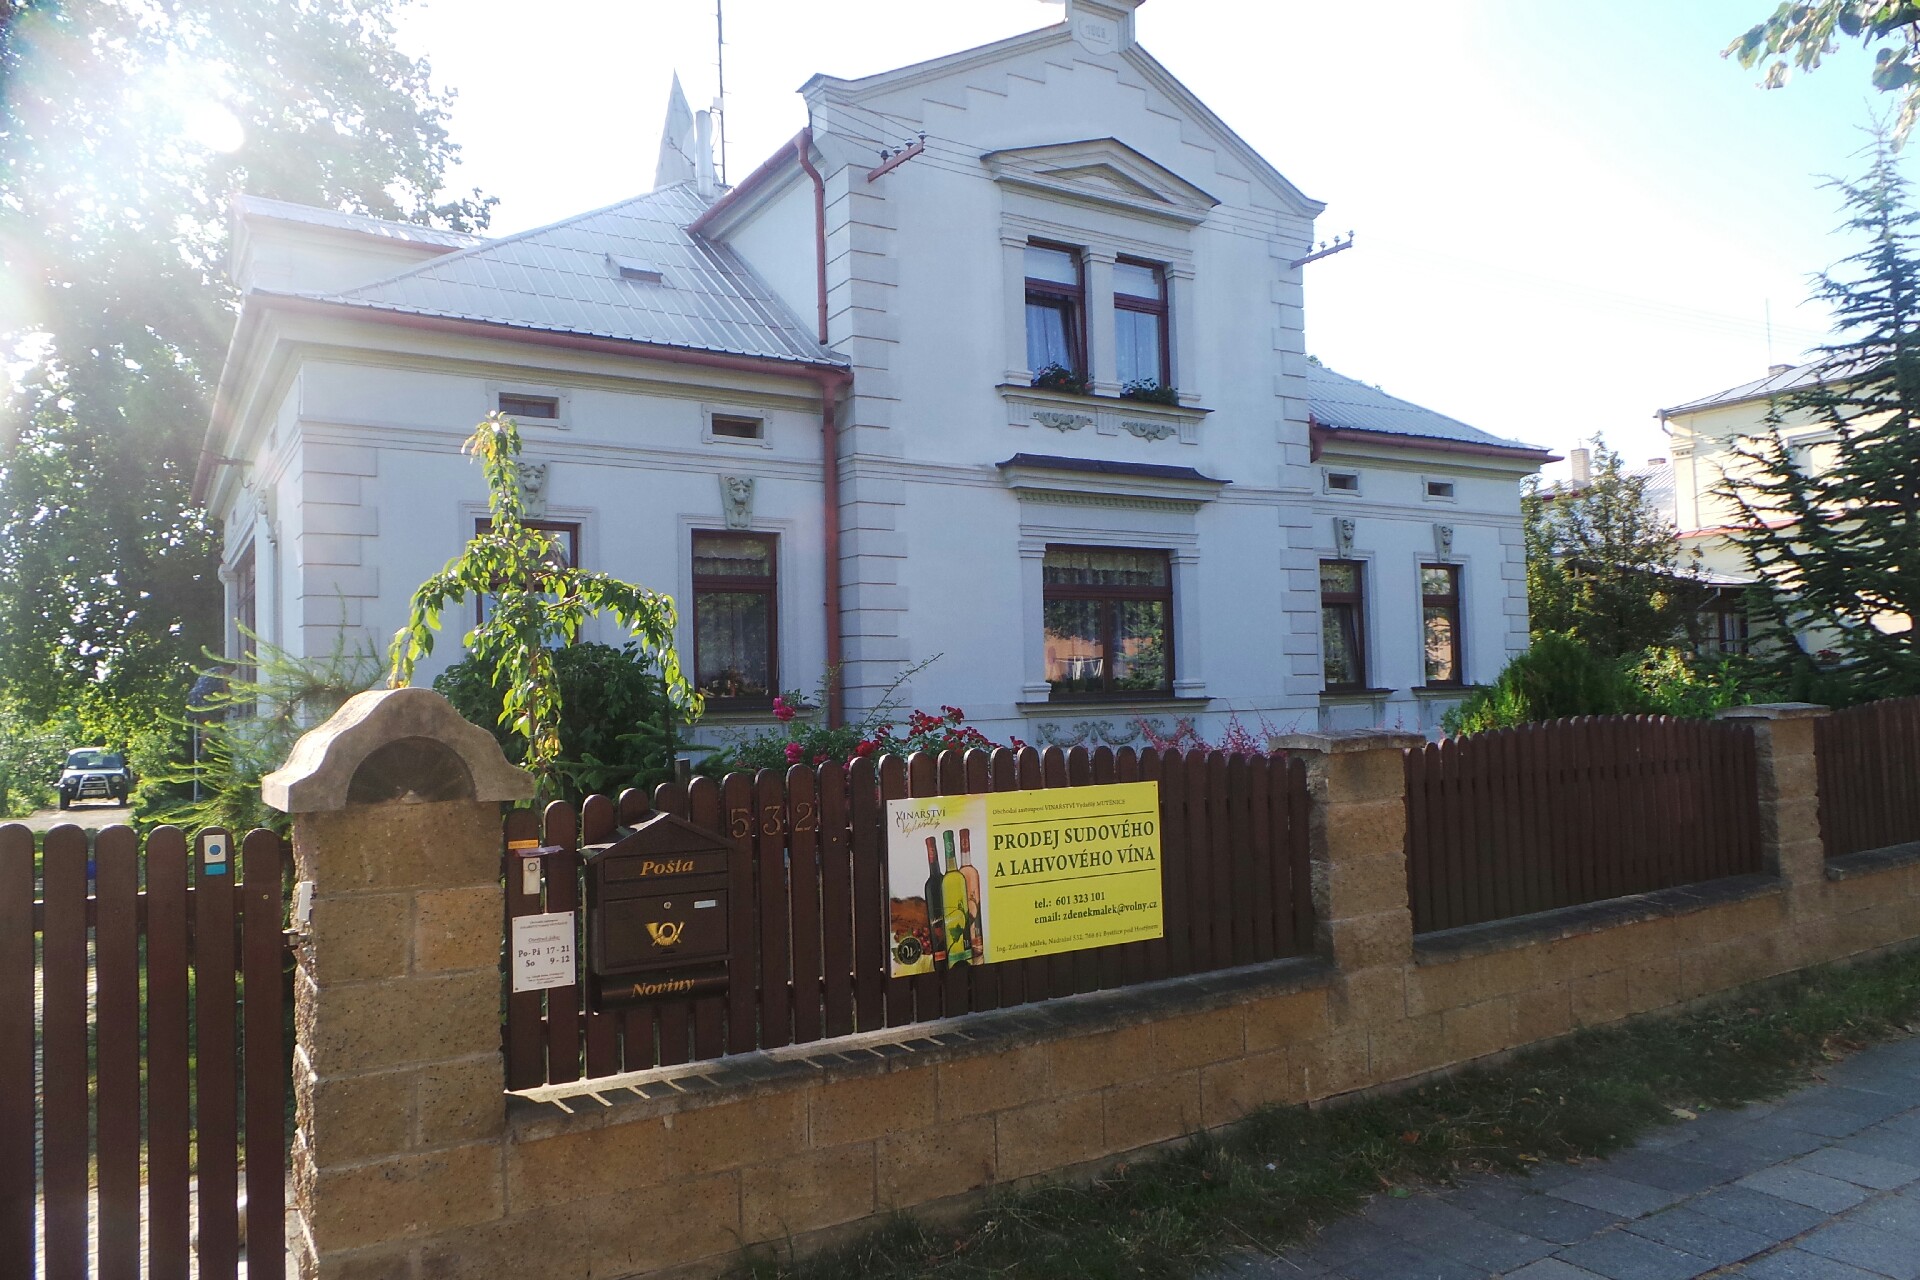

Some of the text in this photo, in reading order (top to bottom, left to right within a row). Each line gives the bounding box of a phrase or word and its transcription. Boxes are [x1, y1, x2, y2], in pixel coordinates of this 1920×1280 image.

[895, 807, 946, 820] VINAŘSTVÍ
[1045, 802, 1075, 811] VINAŘSTVÍ
[731, 802, 813, 838] 532
[993, 819, 1154, 850] PRODEJ SUDOVÉHO
[640, 859, 694, 876] Pošta
[994, 844, 1155, 877] A LAHVOVÉHO VÍNA
[1034, 891, 1105, 909] tel.: 601 323 101
[1034, 901, 1158, 924] email: zdenekmalek@volny.cz
[546, 946, 556, 955] 17
[560, 944, 570, 953] 21
[549, 957, 555, 965] 9
[561, 955, 570, 963] 12
[631, 978, 695, 997] Noviny
